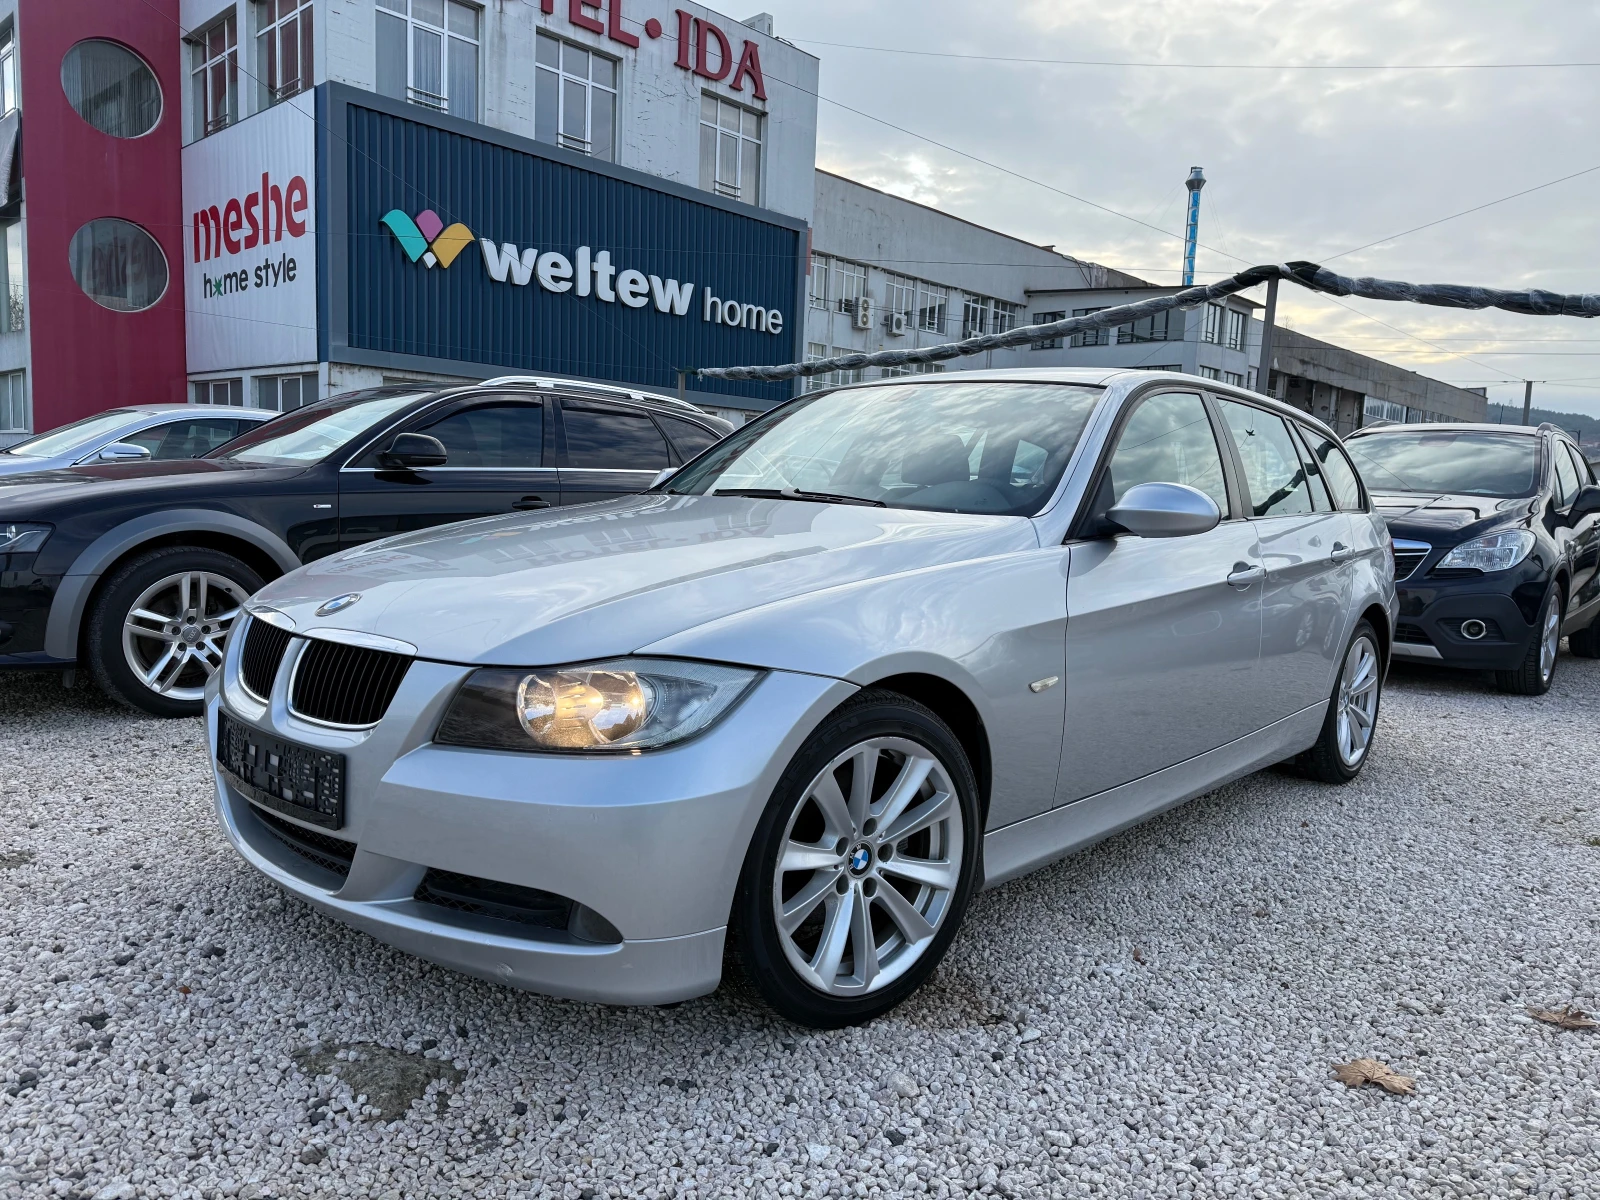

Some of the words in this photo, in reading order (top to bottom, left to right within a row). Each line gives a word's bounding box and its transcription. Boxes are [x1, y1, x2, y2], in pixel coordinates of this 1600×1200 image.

[540, 0, 640, 48] EL
[674, 9, 768, 100] IDA
[193, 172, 308, 264] meshe
[203, 269, 249, 300] hme
[254, 253, 297, 288] style
[479, 237, 695, 316] weltew
[703, 286, 783, 334] home
